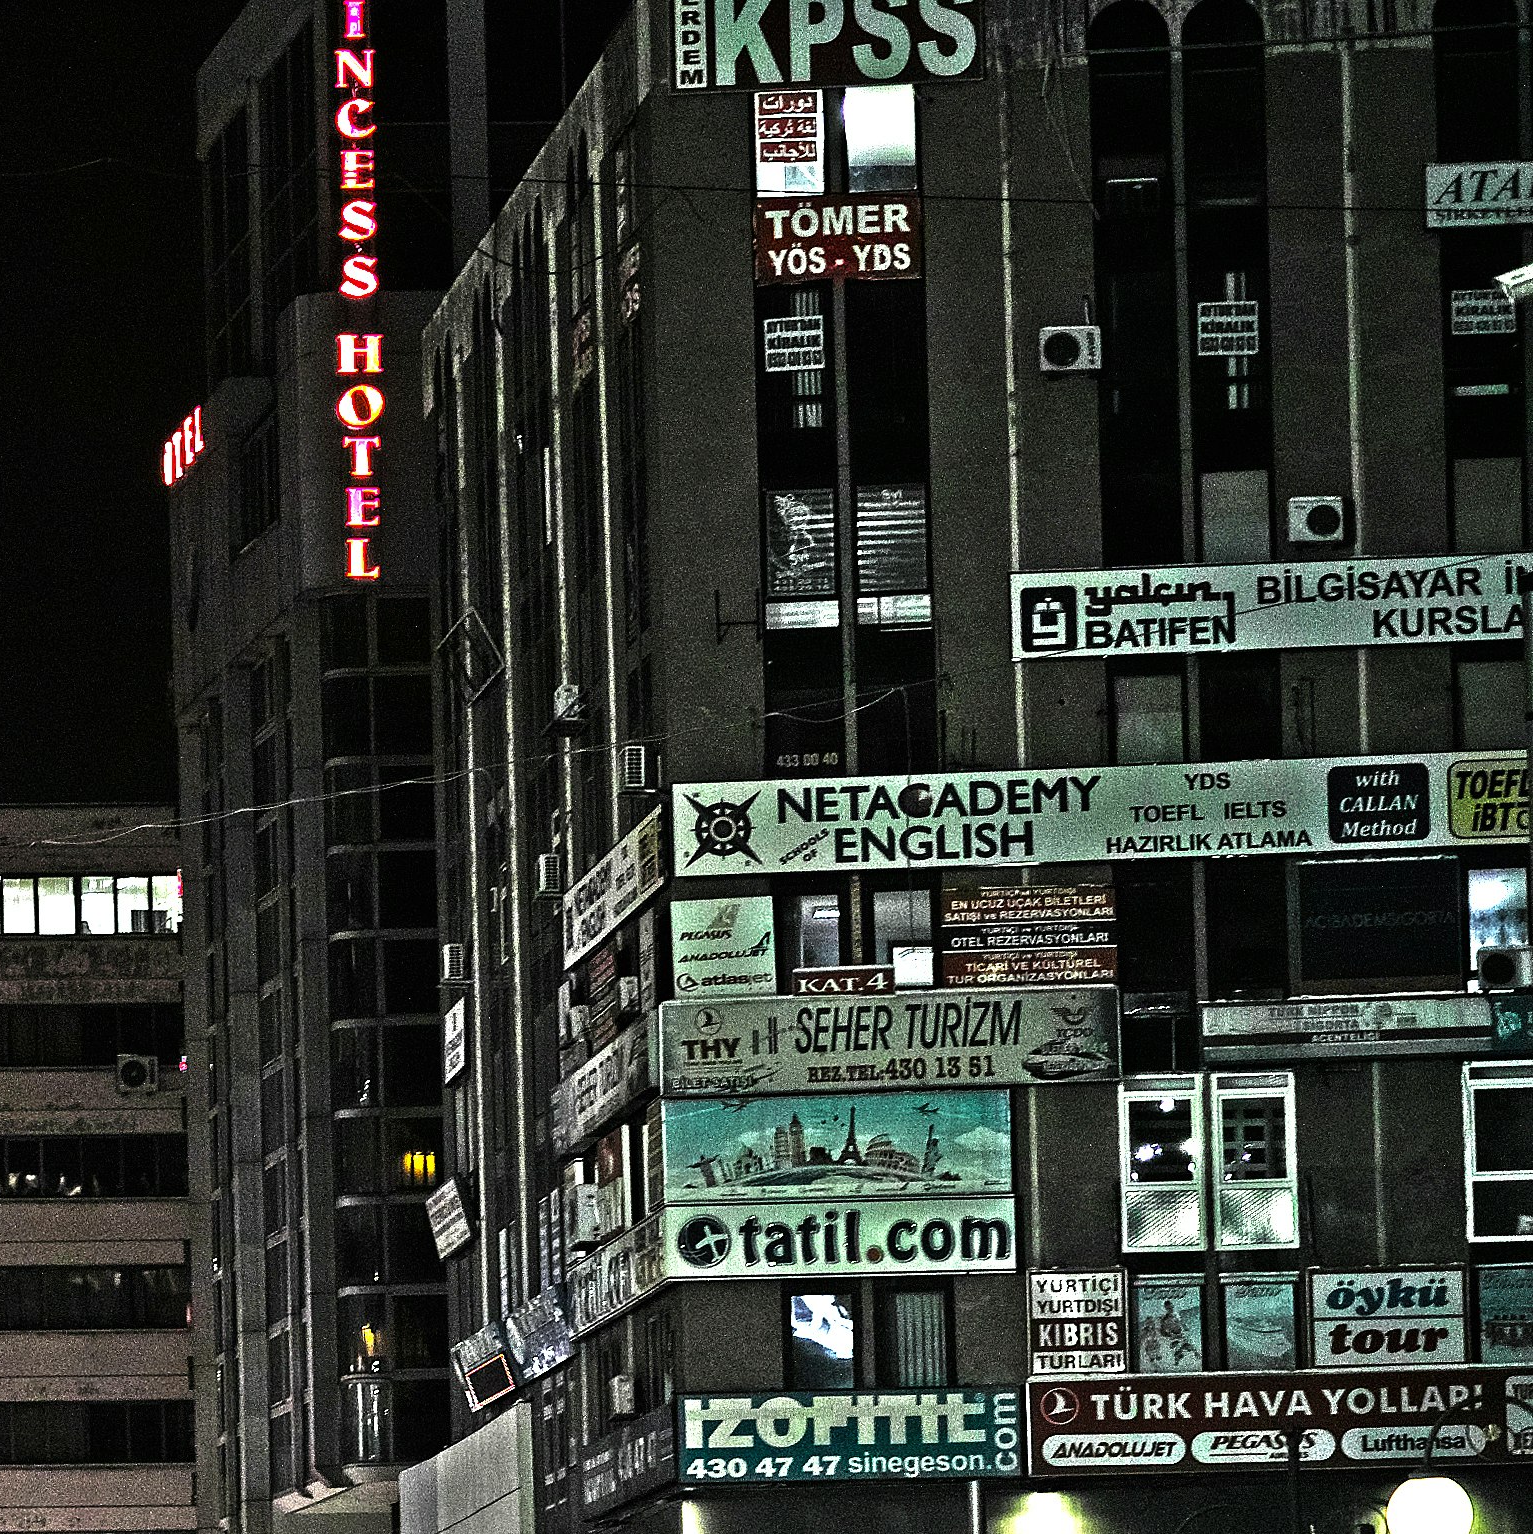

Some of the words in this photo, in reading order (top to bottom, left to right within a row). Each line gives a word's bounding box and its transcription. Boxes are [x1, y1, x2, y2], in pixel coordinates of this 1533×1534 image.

[681, 0, 704, 85] RDEM
[715, 0, 977, 86] KPSS
[1433, 169, 1533, 205] ATA
[765, 202, 911, 240] TÖMER
[768, 243, 826, 277] YÖS
[852, 243, 911, 273] YDS
[335, 334, 383, 580] HOTEL
[1257, 565, 1481, 604] BİLGİSAYAR
[1184, 773, 1230, 791] YDS
[1355, 769, 1400, 787] with
[777, 776, 1101, 823] NETACADEMY
[1339, 794, 1418, 813] CALLAN
[1130, 805, 1203, 823] TOEFL
[1224, 801, 1287, 819] IELTS
[1341, 820, 1417, 839] Method
[779, 828, 829, 866] SCHOOLS
[835, 821, 1033, 863] ENGLISH
[1106, 834, 1211, 853] HAZIRLIK
[1218, 830, 1312, 850] ATLAMA
[803, 848, 819, 862] OF
[951, 901, 968, 910] EN
[972, 899, 1004, 910] UCUZ
[1007, 897, 1042, 909] UÇAK
[1045, 894, 1107, 907] BİLETLERİ
[1000, 907, 1114, 920] REZERVASYONLARI
[680, 929, 733, 941] PEGASUS
[951, 938, 984, 948] OTEL
[987, 932, 1109, 946] REZERVASYONLARI
[965, 962, 1009, 973] TİCARİ
[1011, 962, 1029, 971] VE
[701, 972, 773, 987] atlasjet
[947, 974, 974, 985] TUR
[795, 1005, 893, 1053] SEHER
[905, 996, 1023, 1049] TURİZM
[682, 1037, 742, 1060] THY
[936, 1056, 961, 1079] 13
[969, 1055, 996, 1078] 51
[739, 1210, 1012, 1268] tatil.com
[1036, 1275, 1120, 1296] YURTİÇİ
[1326, 1278, 1449, 1316] öykü
[1036, 1297, 1120, 1316] YURTDIŞI
[1039, 1323, 1119, 1347] KIBRIS
[1329, 1322, 1449, 1356] tour
[1037, 1351, 1122, 1371] TURLARI
[1091, 1386, 1191, 1421] TÜRK
[1205, 1388, 1312, 1418] HAVA
[1322, 1383, 1483, 1415] YOLLARI
[993, 1393, 1018, 1471] com
[1052, 1441, 1178, 1459] ANADOLUJET
[686, 1458, 747, 1479] 430
[755, 1456, 794, 1477] 47
[802, 1455, 841, 1477] 47
